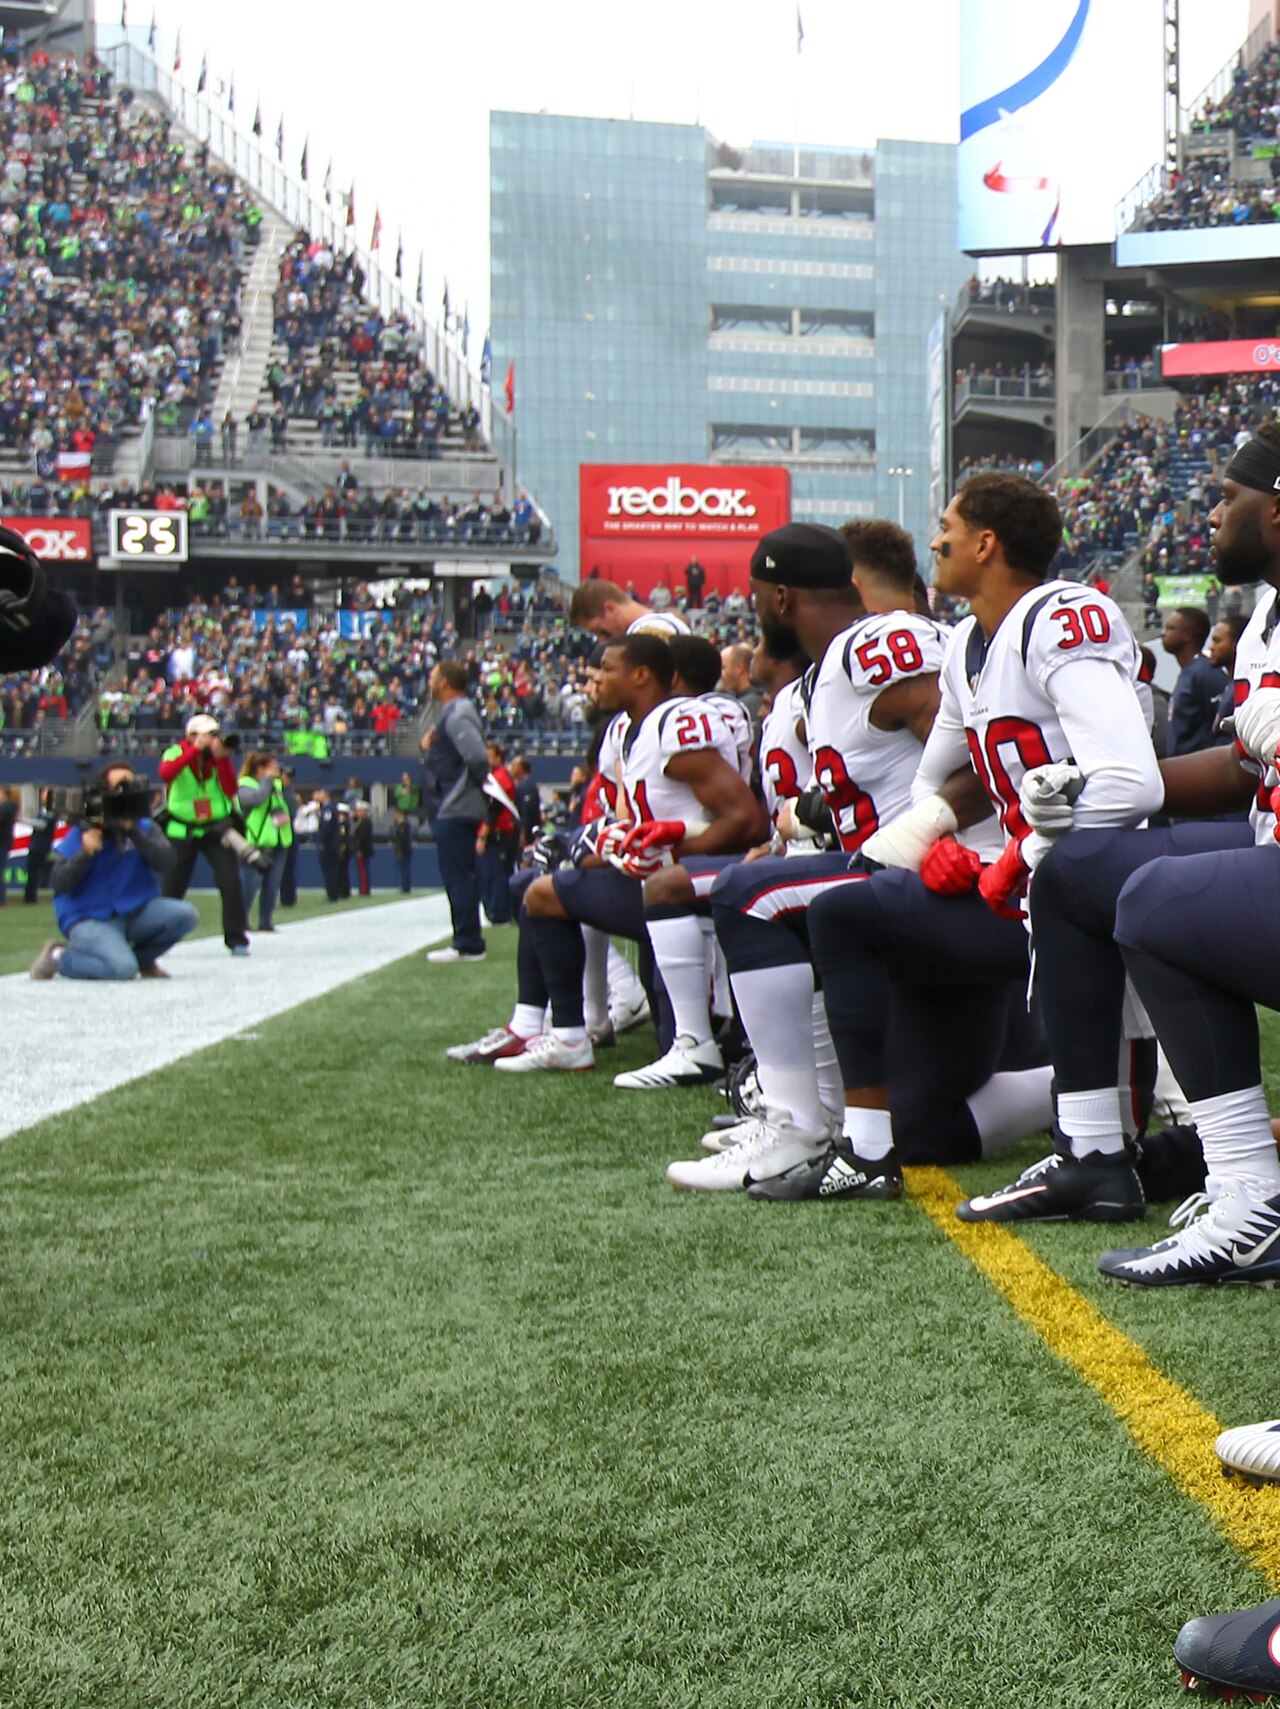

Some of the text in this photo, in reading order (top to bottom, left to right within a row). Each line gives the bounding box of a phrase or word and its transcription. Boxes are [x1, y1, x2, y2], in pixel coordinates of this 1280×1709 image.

[122, 516, 176, 554] 25
[1050, 604, 1110, 649] 30
[855, 629, 923, 685] 58
[675, 714, 713, 747] 21
[819, 1172, 867, 1195] adidas
